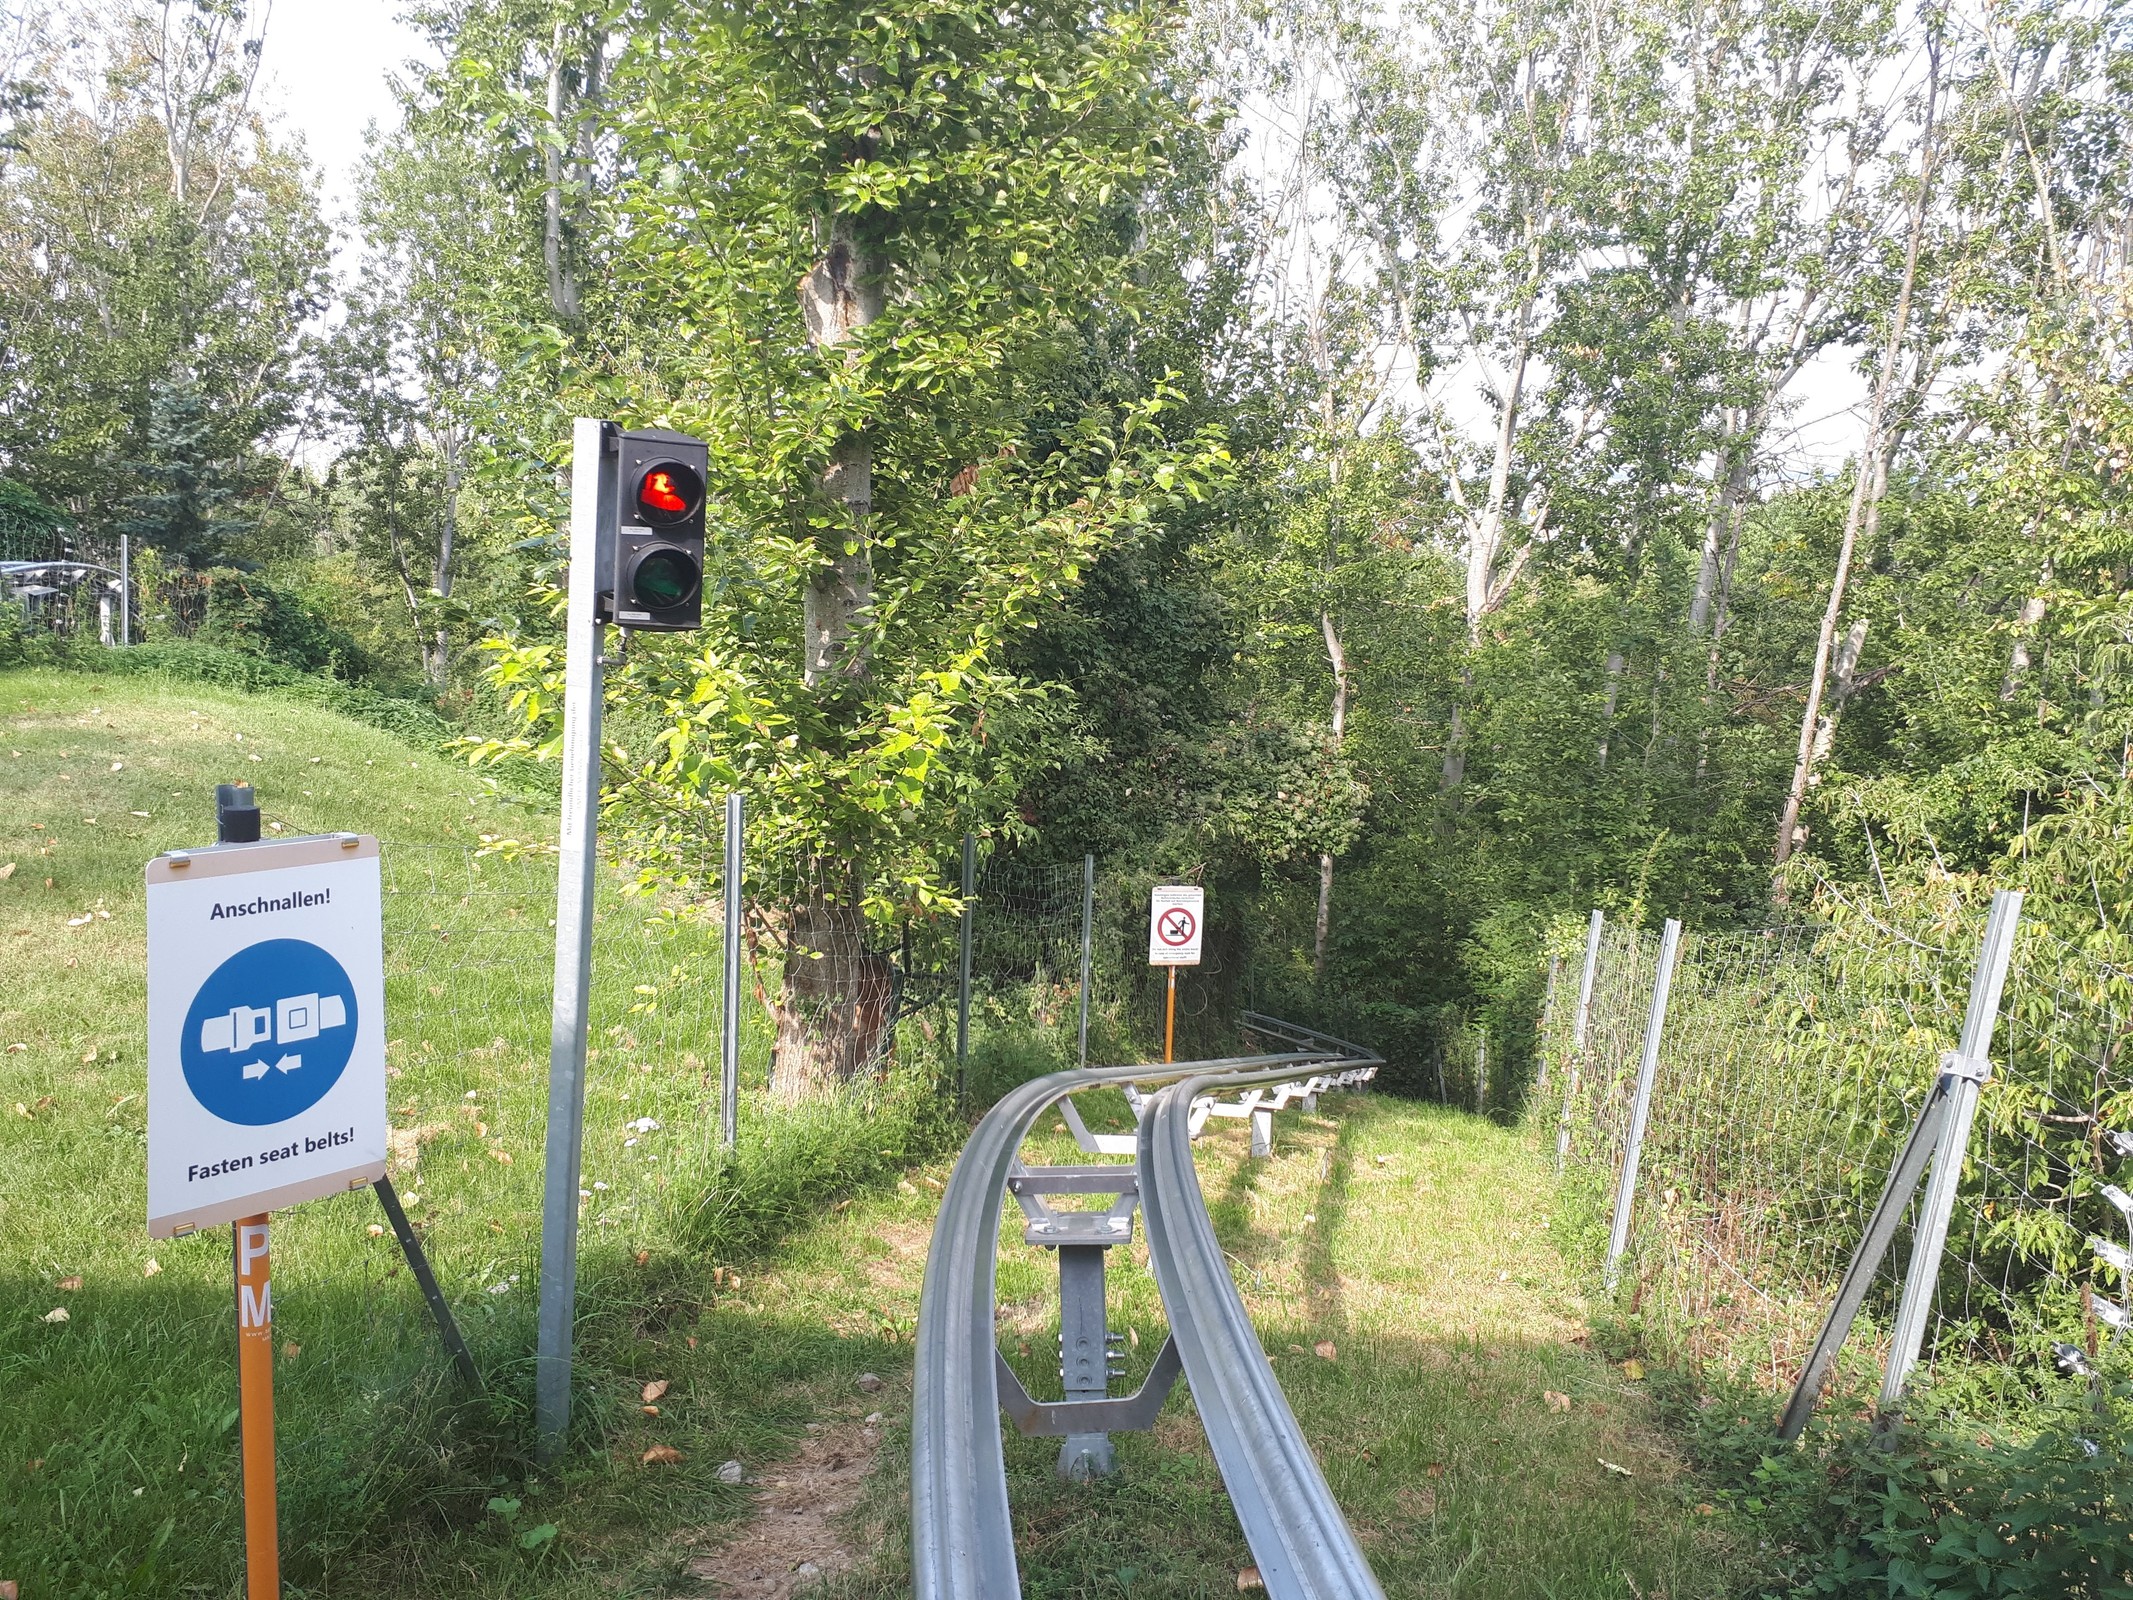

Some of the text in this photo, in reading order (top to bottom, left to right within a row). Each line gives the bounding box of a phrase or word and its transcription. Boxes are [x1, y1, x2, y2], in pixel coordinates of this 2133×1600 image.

[210, 887, 331, 921] Anschnallen!
[188, 1127, 355, 1182] Fasten seat belts!
